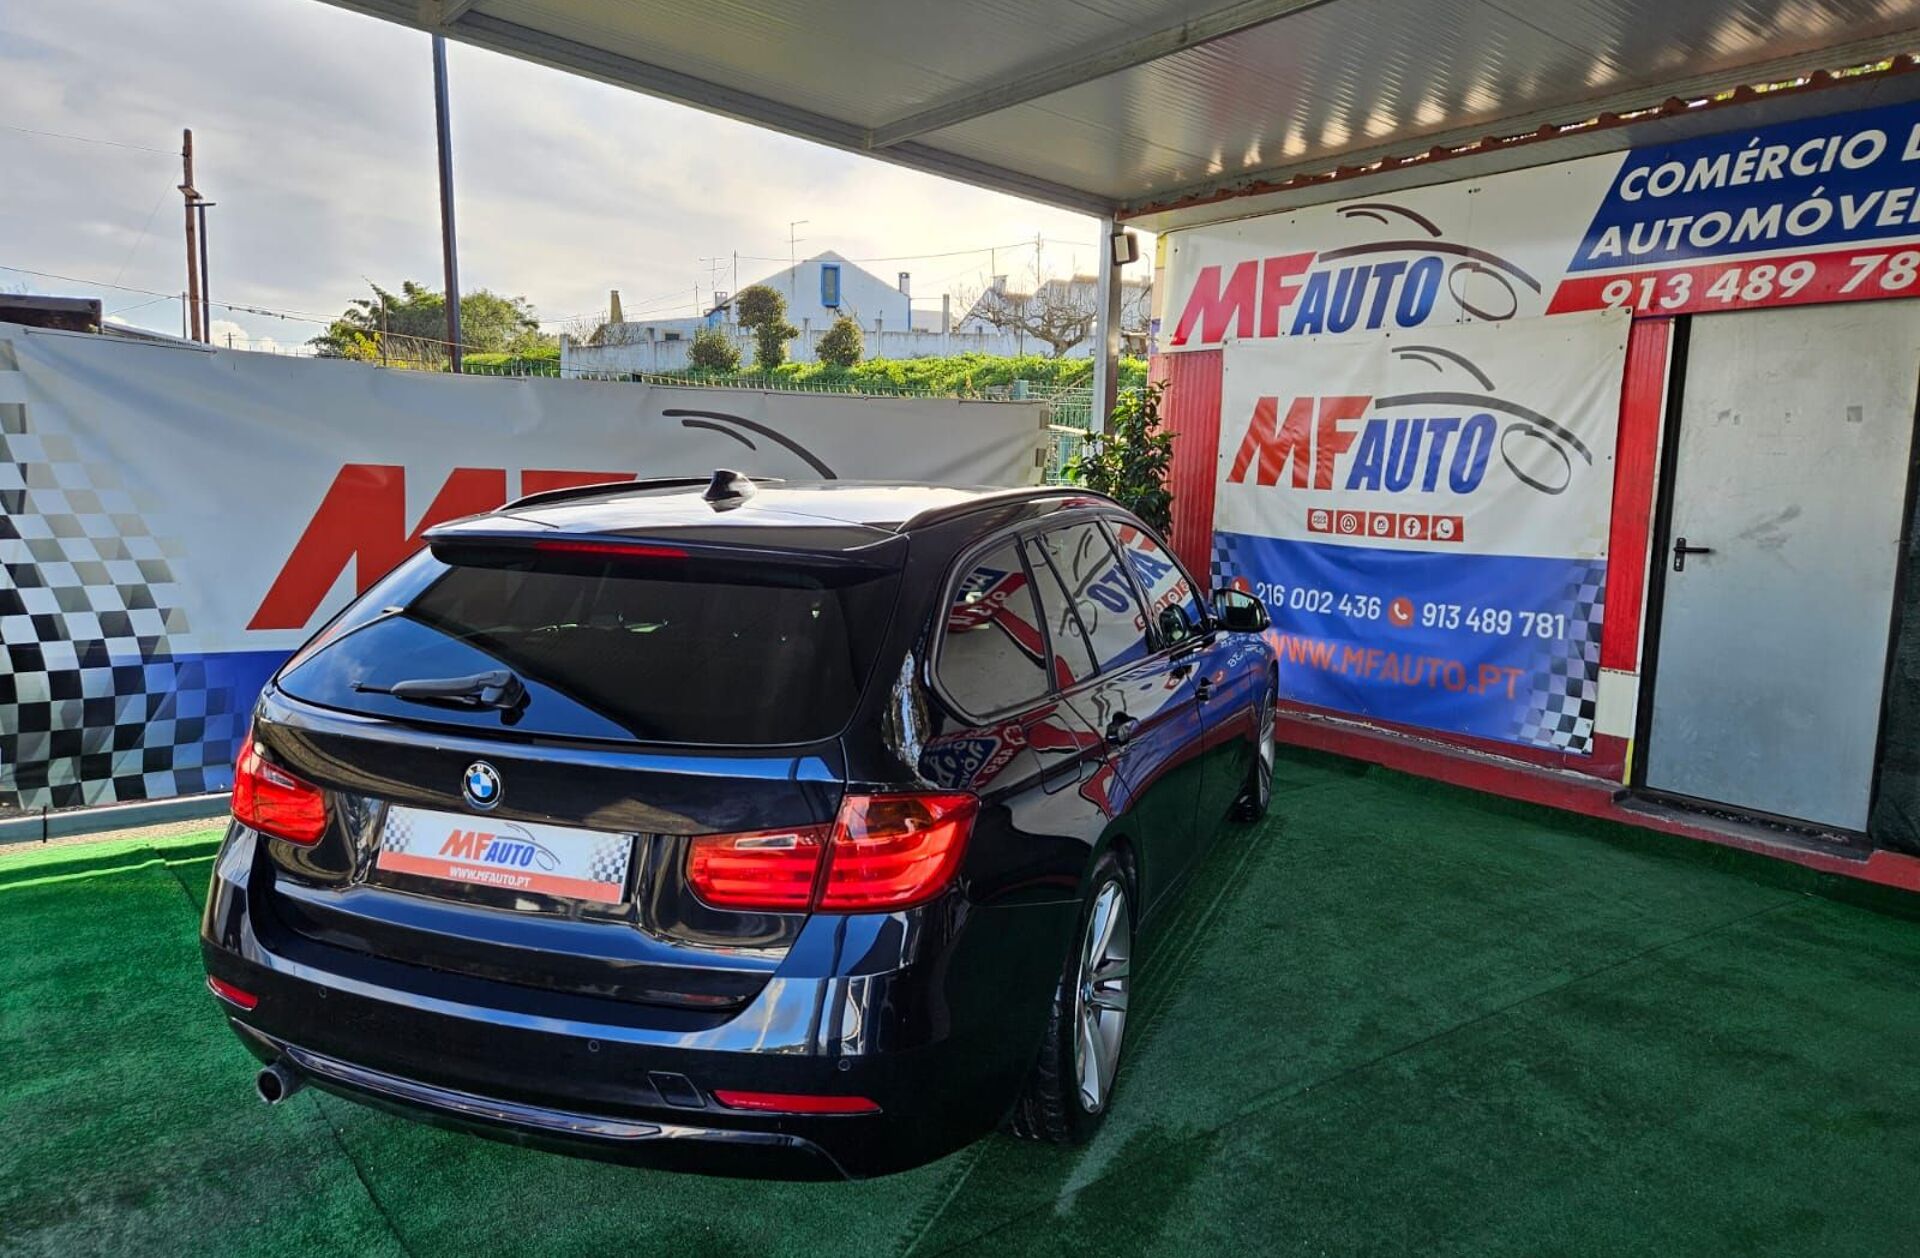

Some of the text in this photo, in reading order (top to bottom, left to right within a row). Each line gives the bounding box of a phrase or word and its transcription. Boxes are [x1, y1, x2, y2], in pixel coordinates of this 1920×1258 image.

[1619, 129, 1888, 202] COMÉRCIO
[1601, 272, 1694, 311] 913
[1705, 260, 1817, 304] 489
[246, 463, 636, 630] M
[1256, 582, 1565, 640] 216 002 436 913 489 781
